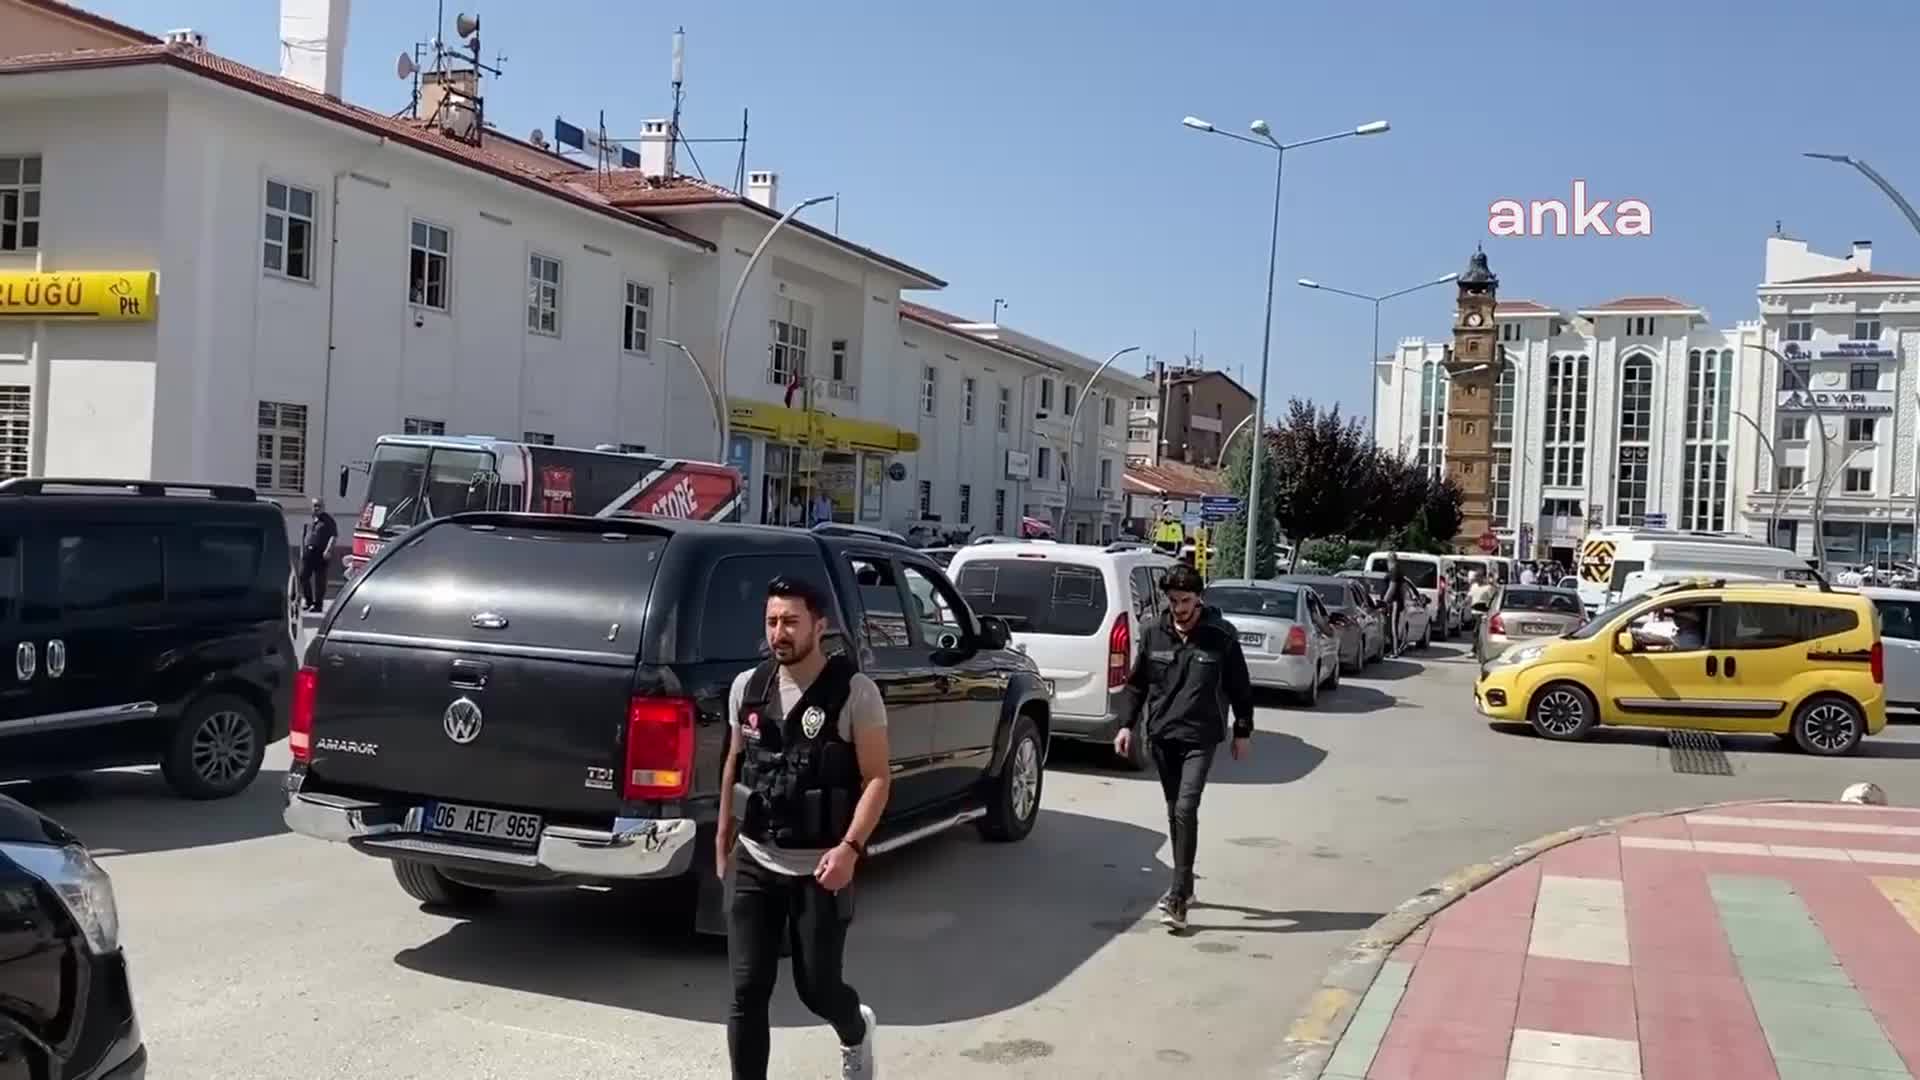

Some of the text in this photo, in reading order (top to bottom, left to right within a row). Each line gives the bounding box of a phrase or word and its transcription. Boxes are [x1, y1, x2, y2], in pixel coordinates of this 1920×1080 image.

[0, 276, 82, 306] LÜĞÜ
[315, 738, 379, 756] AMAROK
[587, 766, 614, 780] TDI
[435, 805, 538, 839] 06 AET 965
